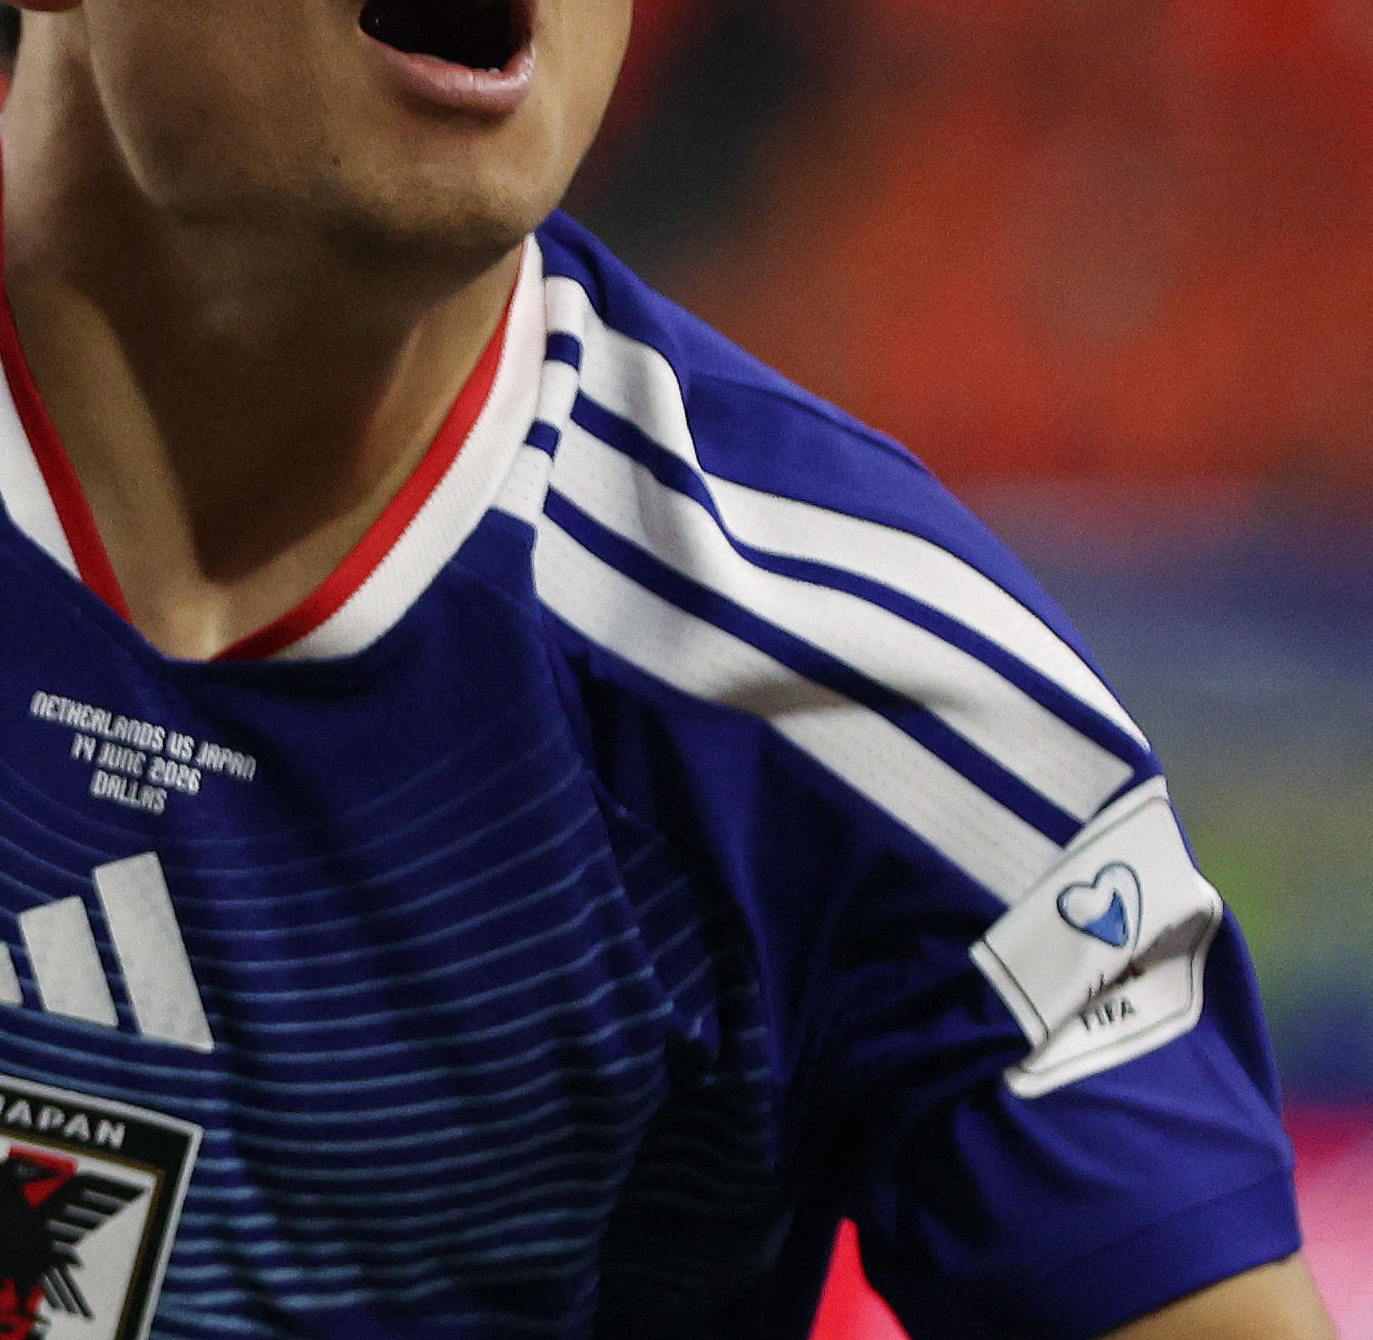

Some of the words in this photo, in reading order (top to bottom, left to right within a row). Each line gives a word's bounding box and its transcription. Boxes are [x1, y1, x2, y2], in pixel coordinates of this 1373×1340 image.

[30, 690, 165, 752] NETHERLANDS
[195, 741, 256, 781] JAPAN
[90, 769, 167, 814] DALLAS
[97, 742, 146, 777] JUNE
[148, 756, 201, 796] 2026
